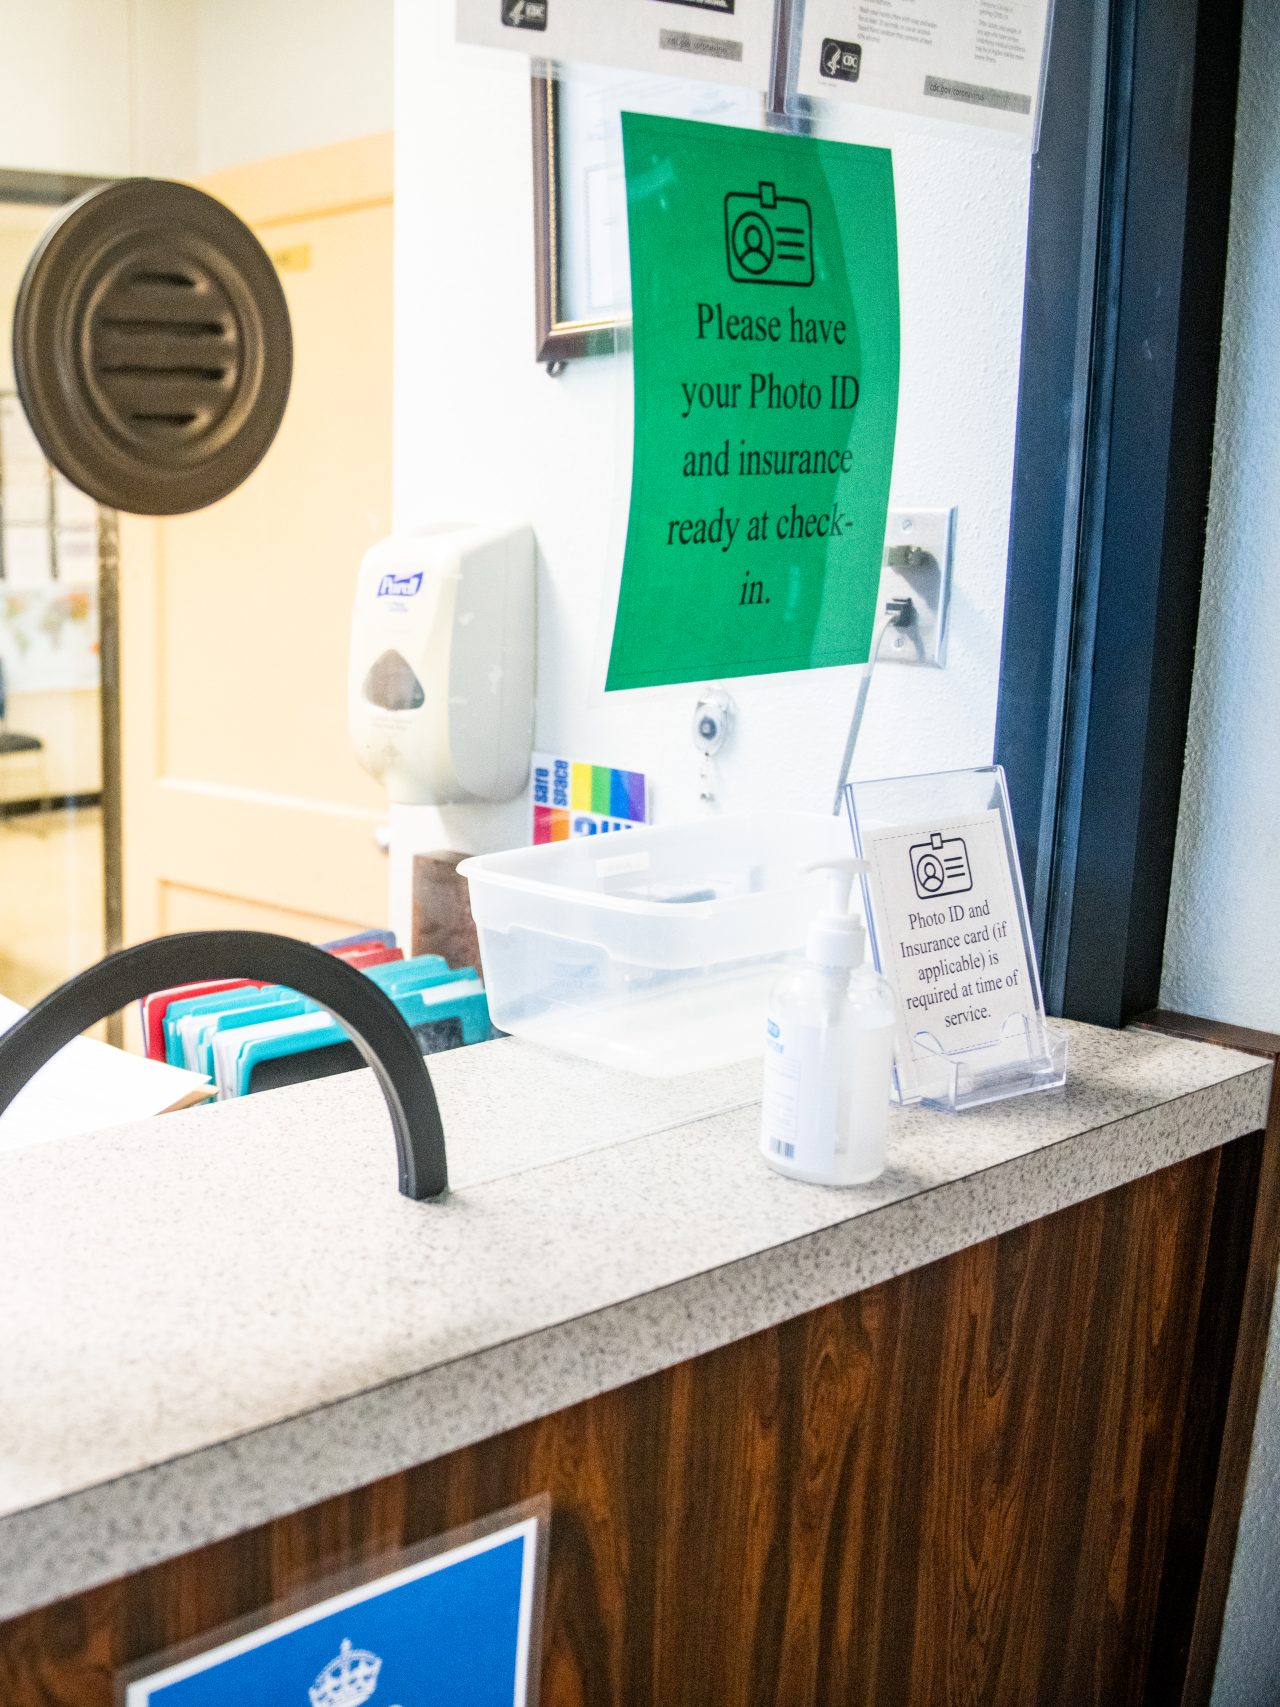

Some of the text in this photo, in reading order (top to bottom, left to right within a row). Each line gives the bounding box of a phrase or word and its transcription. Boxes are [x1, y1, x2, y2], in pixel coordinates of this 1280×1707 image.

[696, 302, 847, 345] Please have
[681, 371, 860, 419] your Photo ID
[683, 439, 854, 477] and insurance
[666, 503, 854, 553] ready at check-
[738, 570, 770, 605] in.
[534, 767, 549, 803] safe
[553, 759, 568, 806] space
[908, 899, 991, 931] Photo ID and
[900, 920, 1008, 958] Insurance card (if
[917, 949, 1000, 984] applicable) is
[906, 969, 1019, 1011] required at time of
[944, 1005, 992, 1028] service.
